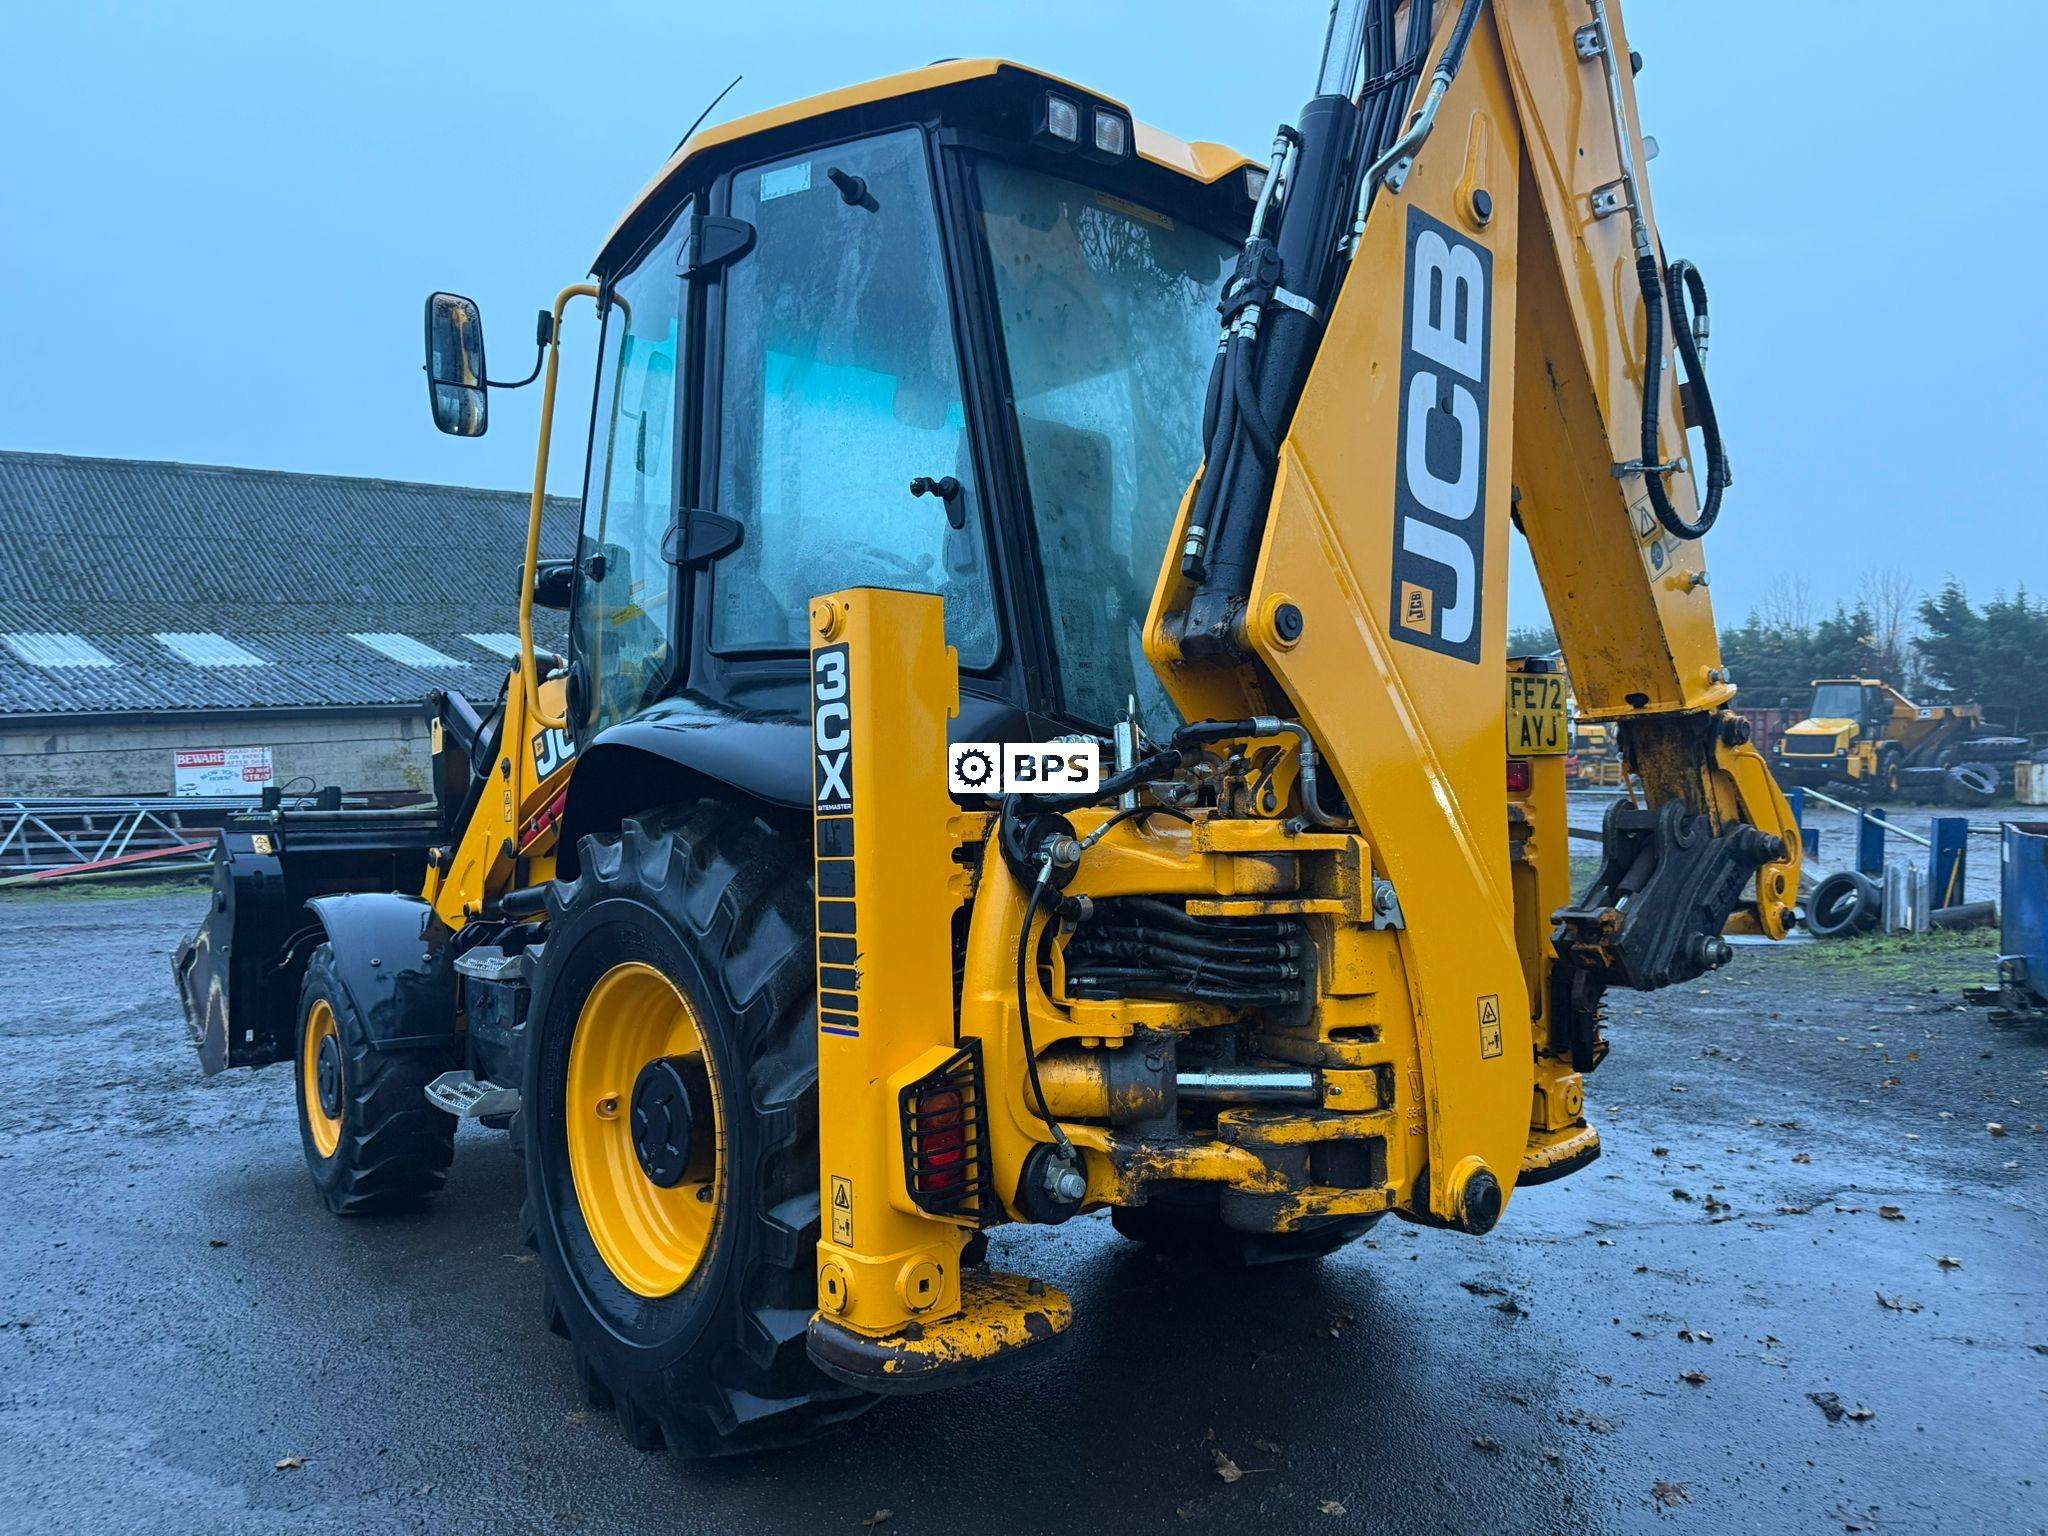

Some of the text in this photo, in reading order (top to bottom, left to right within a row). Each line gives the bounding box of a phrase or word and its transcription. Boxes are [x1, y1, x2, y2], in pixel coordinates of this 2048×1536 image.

[1403, 230, 1483, 643] JCB
[1409, 593, 1424, 619] JCB
[1511, 677, 1561, 710] FE72
[816, 651, 851, 800] 3CX
[1521, 715, 1557, 747] AYJ
[178, 752, 225, 764] BEWARE
[537, 728, 576, 776] JC
[243, 773, 271, 781] STRAY
[817, 803, 852, 811] SITEMASTER
